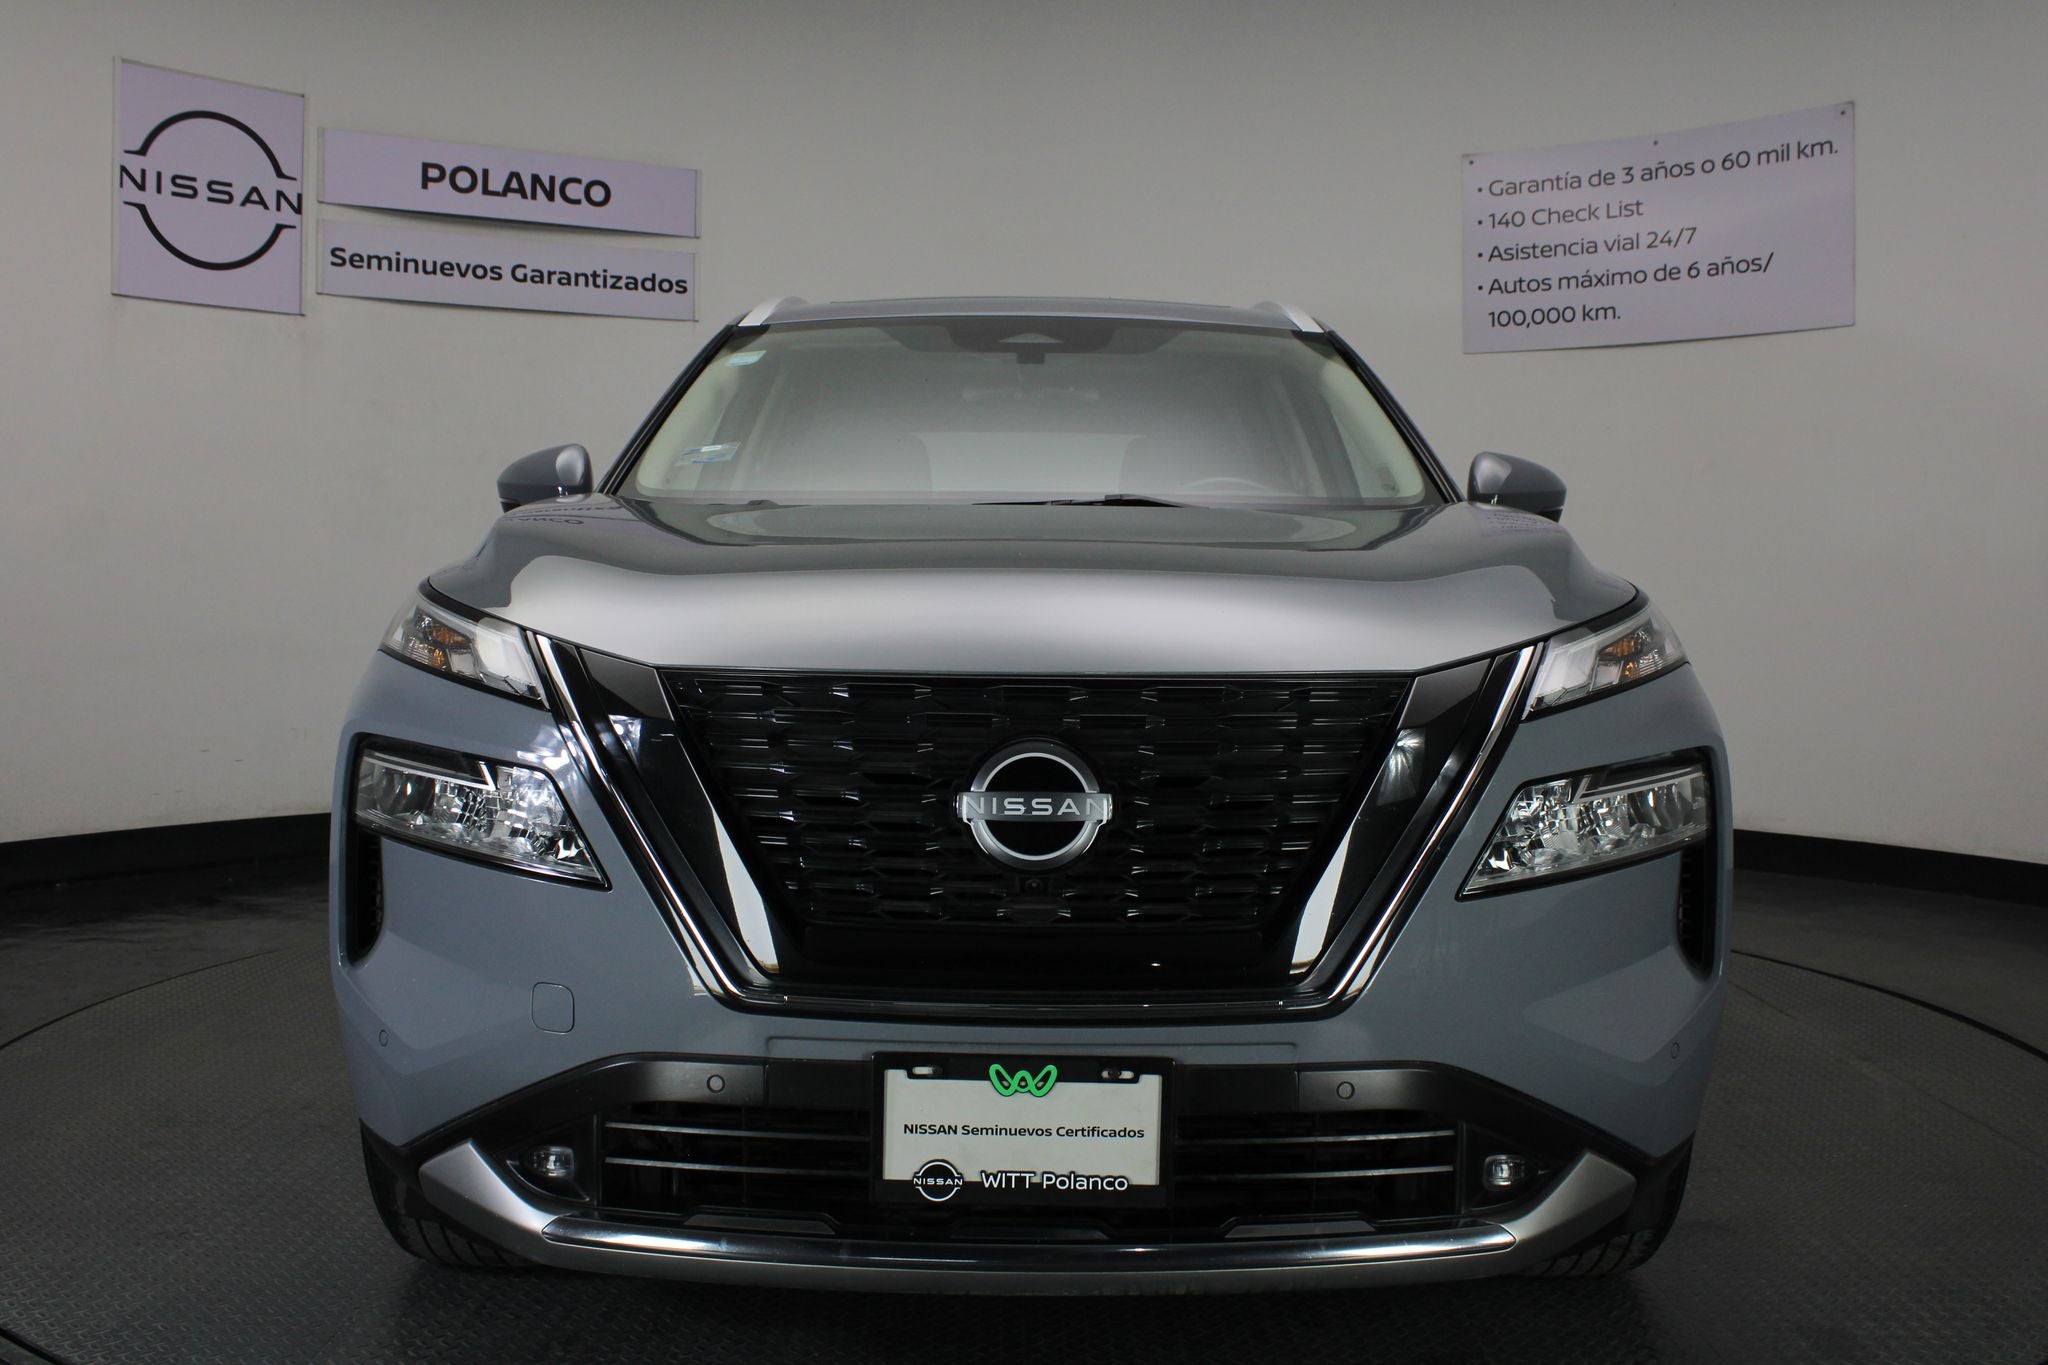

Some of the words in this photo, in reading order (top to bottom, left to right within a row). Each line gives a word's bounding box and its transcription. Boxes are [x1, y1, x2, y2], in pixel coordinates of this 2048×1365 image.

[1489, 171, 1581, 196] Garantía
[1588, 169, 1615, 187] de
[1622, 166, 1634, 184] 3
[1641, 161, 1695, 182] años
[1701, 159, 1715, 174] o
[1722, 151, 1750, 171] 60
[1757, 143, 1790, 166] mil
[1797, 140, 1838, 159] km.
[119, 164, 303, 216] NISSAN
[420, 161, 612, 208] POLANCO
[1488, 211, 1525, 229] 140
[1532, 204, 1599, 225] Check
[1606, 200, 1644, 219] List
[1488, 238, 1598, 262] Asistencia
[1604, 233, 1639, 252] vial
[1646, 227, 1697, 249] 24/7
[329, 246, 503, 282] Seminuevos
[510, 263, 689, 295] Garantizados
[1488, 277, 1552, 295] Autos
[1558, 269, 1647, 290] máximo
[1653, 264, 1681, 282] de
[1687, 261, 1700, 279] 6
[1707, 252, 1774, 277] años/
[1488, 306, 1576, 328] 100,000
[1583, 304, 1621, 322] km.
[962, 796, 1108, 818] NISSAN
[903, 1123, 958, 1136] NISSAN
[961, 1124, 1053, 1137] Seminuevos
[1055, 1126, 1145, 1139] Certificados
[912, 1176, 964, 1186] NISSAN
[980, 1171, 1035, 1190] WITT
[1042, 1173, 1129, 1191] Polanco
